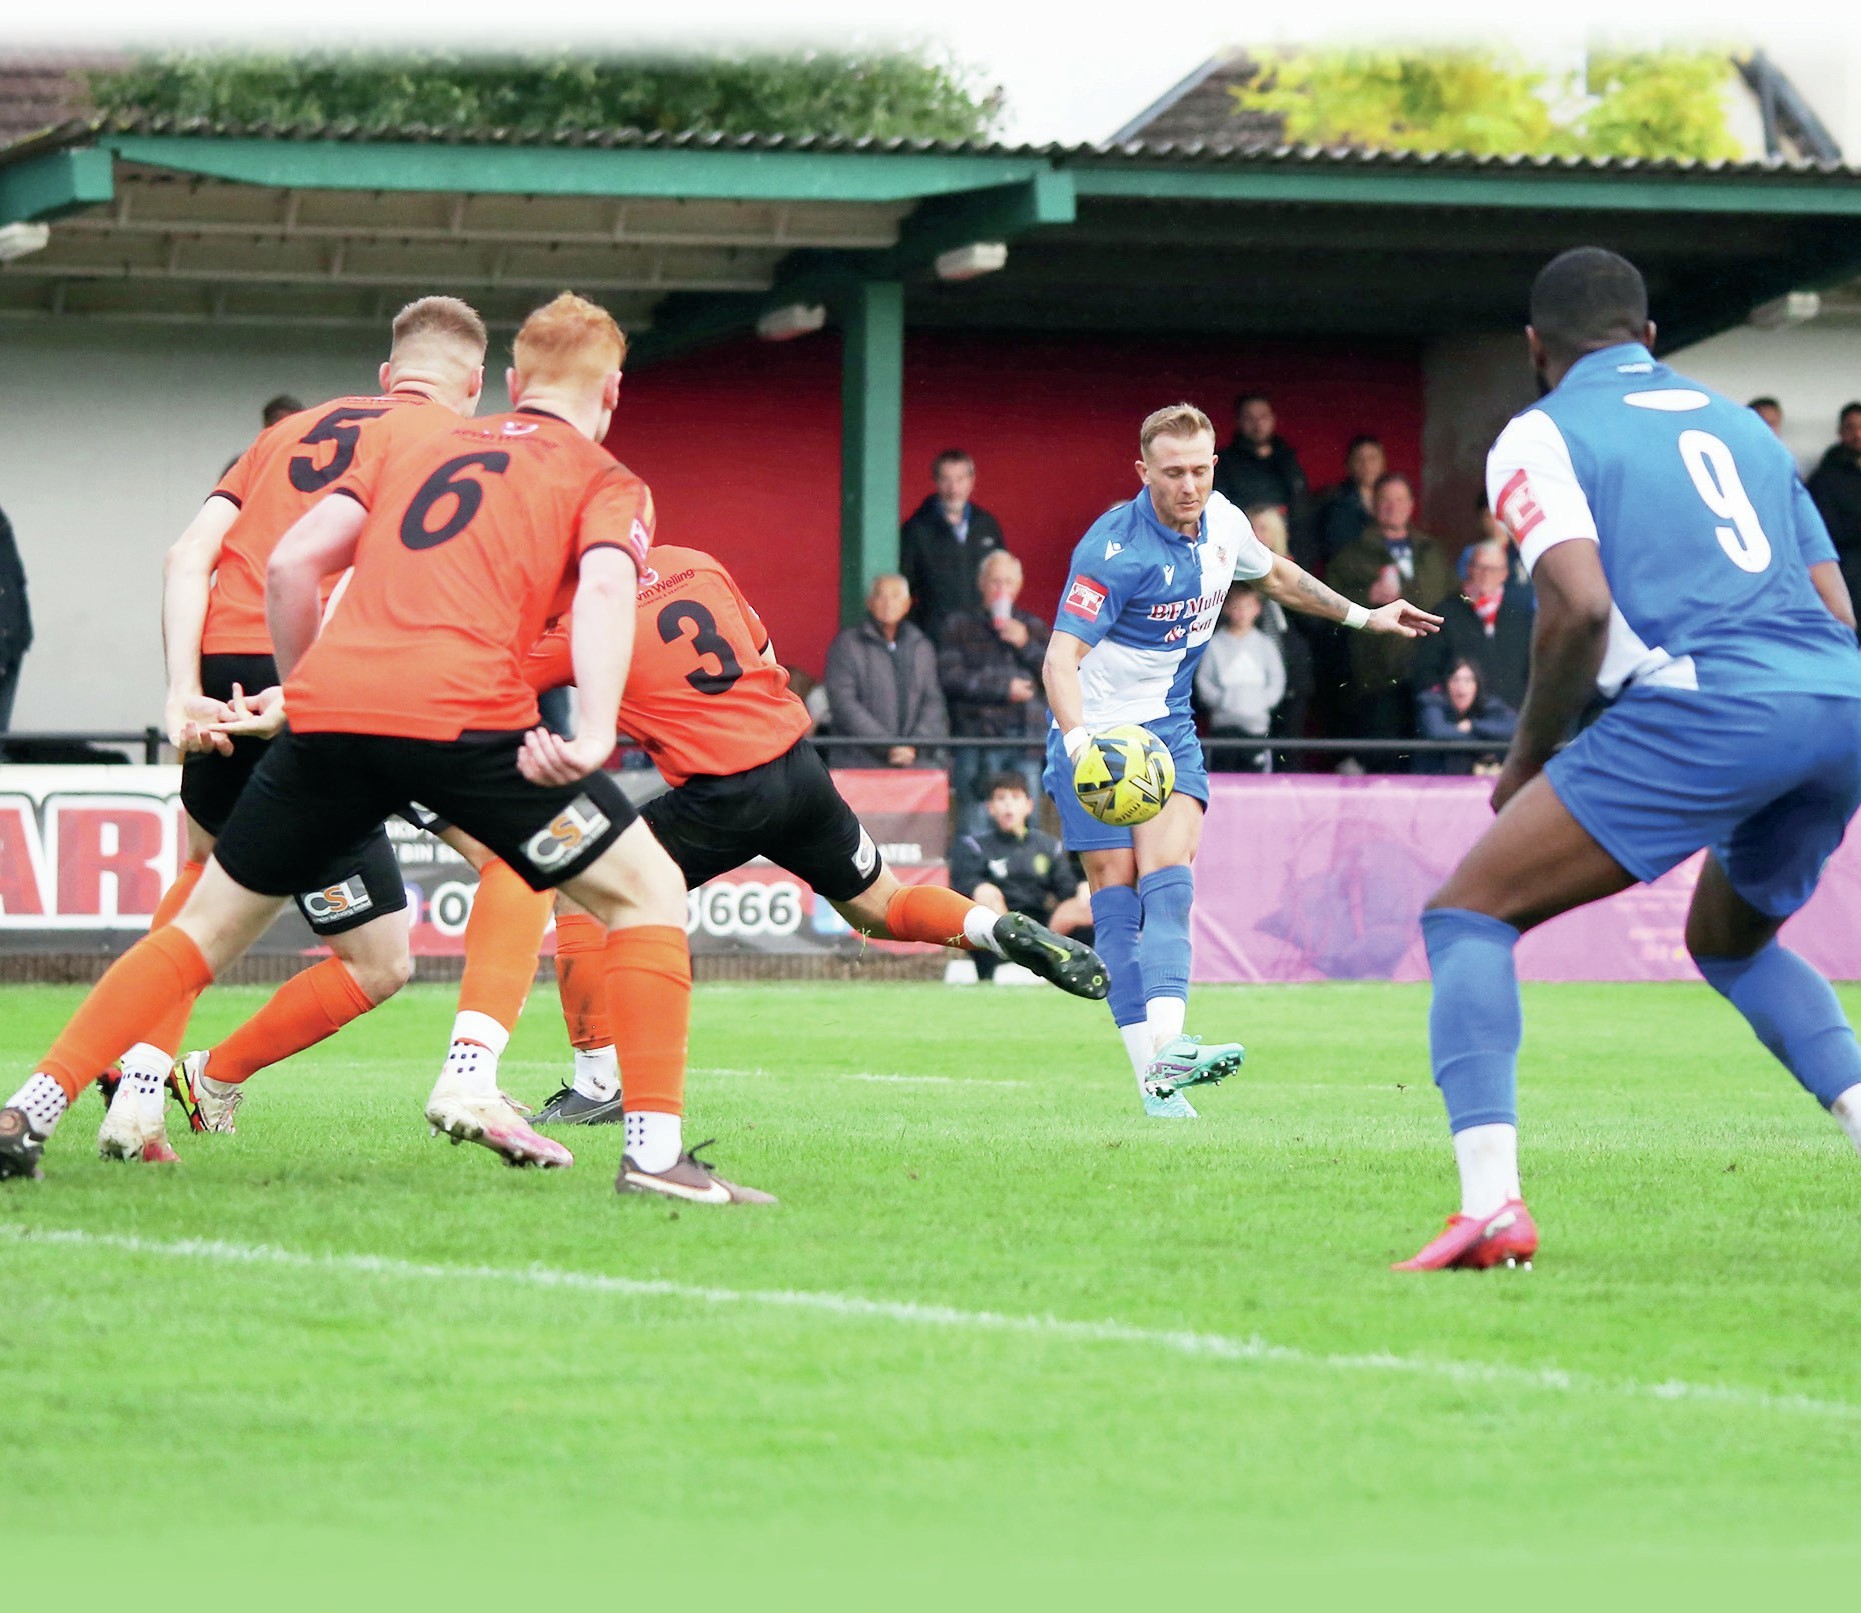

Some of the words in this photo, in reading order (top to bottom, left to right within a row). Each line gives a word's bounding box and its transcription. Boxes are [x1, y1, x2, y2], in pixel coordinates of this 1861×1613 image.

[289, 407, 393, 493] 5
[400, 451, 510, 550] 6
[1678, 429, 1772, 573] 9
[636, 589, 654, 601] vin
[651, 568, 695, 593] Welling
[1149, 602, 1184, 621] BF
[657, 600, 743, 695] 3
[1164, 624, 1186, 642] &
[0, 808, 188, 915] AR
[527, 806, 603, 864] CSL
[304, 882, 369, 917] CSL
[690, 885, 798, 932] 666
